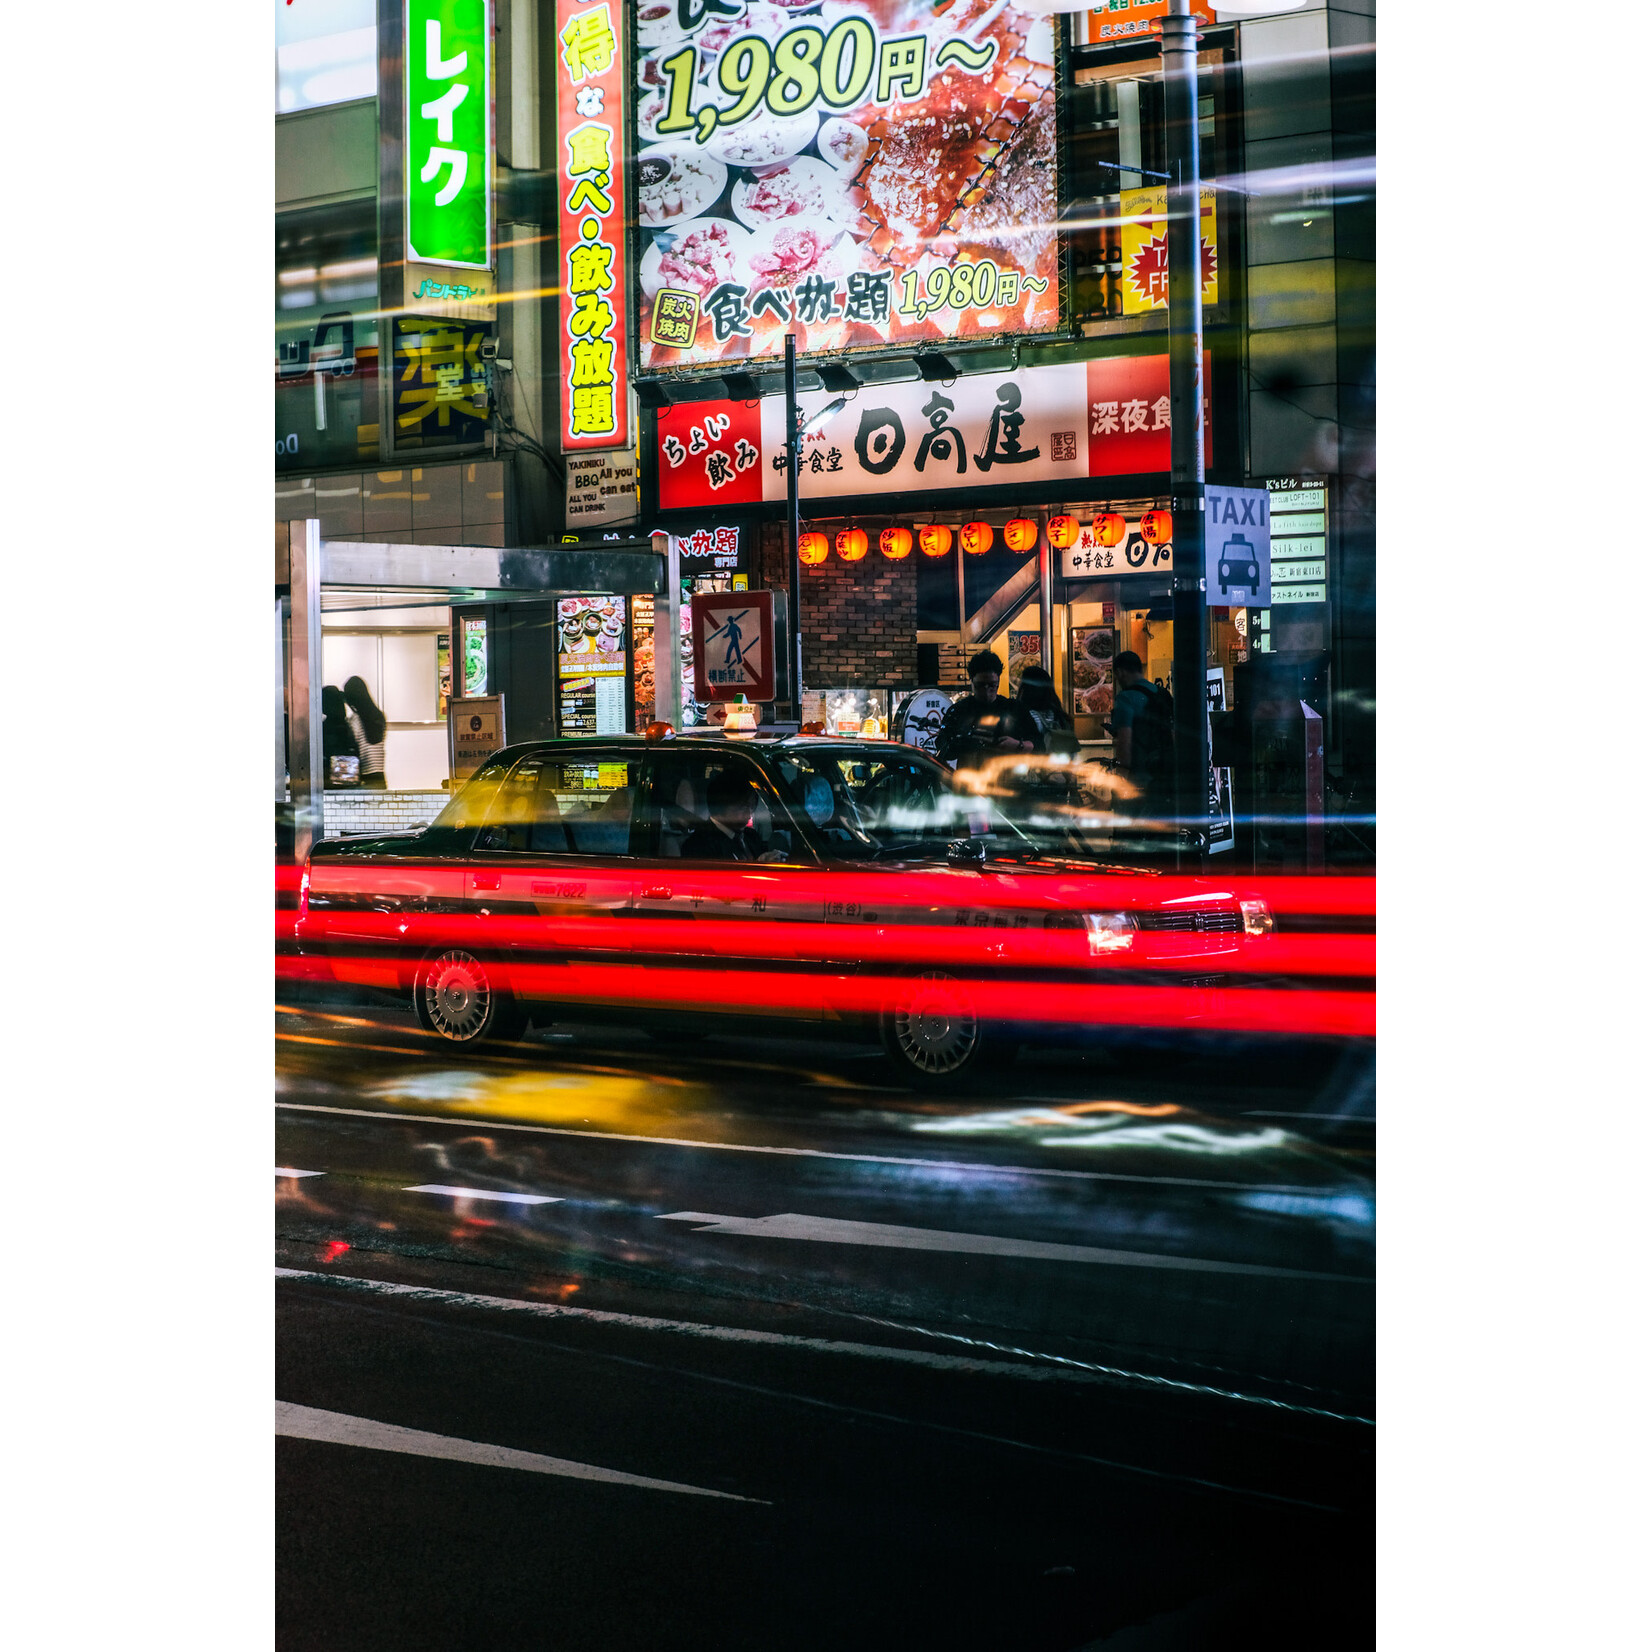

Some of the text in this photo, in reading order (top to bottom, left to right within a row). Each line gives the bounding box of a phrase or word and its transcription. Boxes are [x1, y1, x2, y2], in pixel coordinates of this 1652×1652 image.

[421, 19, 469, 206] レイク
[560, 0, 619, 437] 得な食べ・飲み放題
[660, 296, 693, 320] 炭火
[704, 271, 892, 341] 食べ放題
[657, 317, 691, 339] 焼肉
[1091, 396, 1209, 435] 深夜食
[855, 382, 1040, 474] 日高屋
[662, 414, 731, 467] ちょい
[569, 459, 605, 470] YAKINIKU
[600, 468, 633, 479] All you
[705, 439, 759, 488] 飲み
[575, 474, 599, 488] BBQ
[600, 482, 636, 495] can eat
[569, 495, 581, 503] ALL
[1290, 492, 1320, 501] LOFT-101
[569, 503, 606, 513] CAN DRINK
[1209, 496, 1265, 526] TAXI
[1049, 518, 1066, 542] 餃子
[1094, 516, 1110, 542] サワー
[714, 556, 738, 568] 専門店
[1073, 551, 1114, 570] 中華食堂
[1020, 634, 1041, 655] 35
[708, 669, 746, 682] 横断禁止
[1209, 683, 1221, 697] 101
[827, 902, 861, 916] (渋谷)
